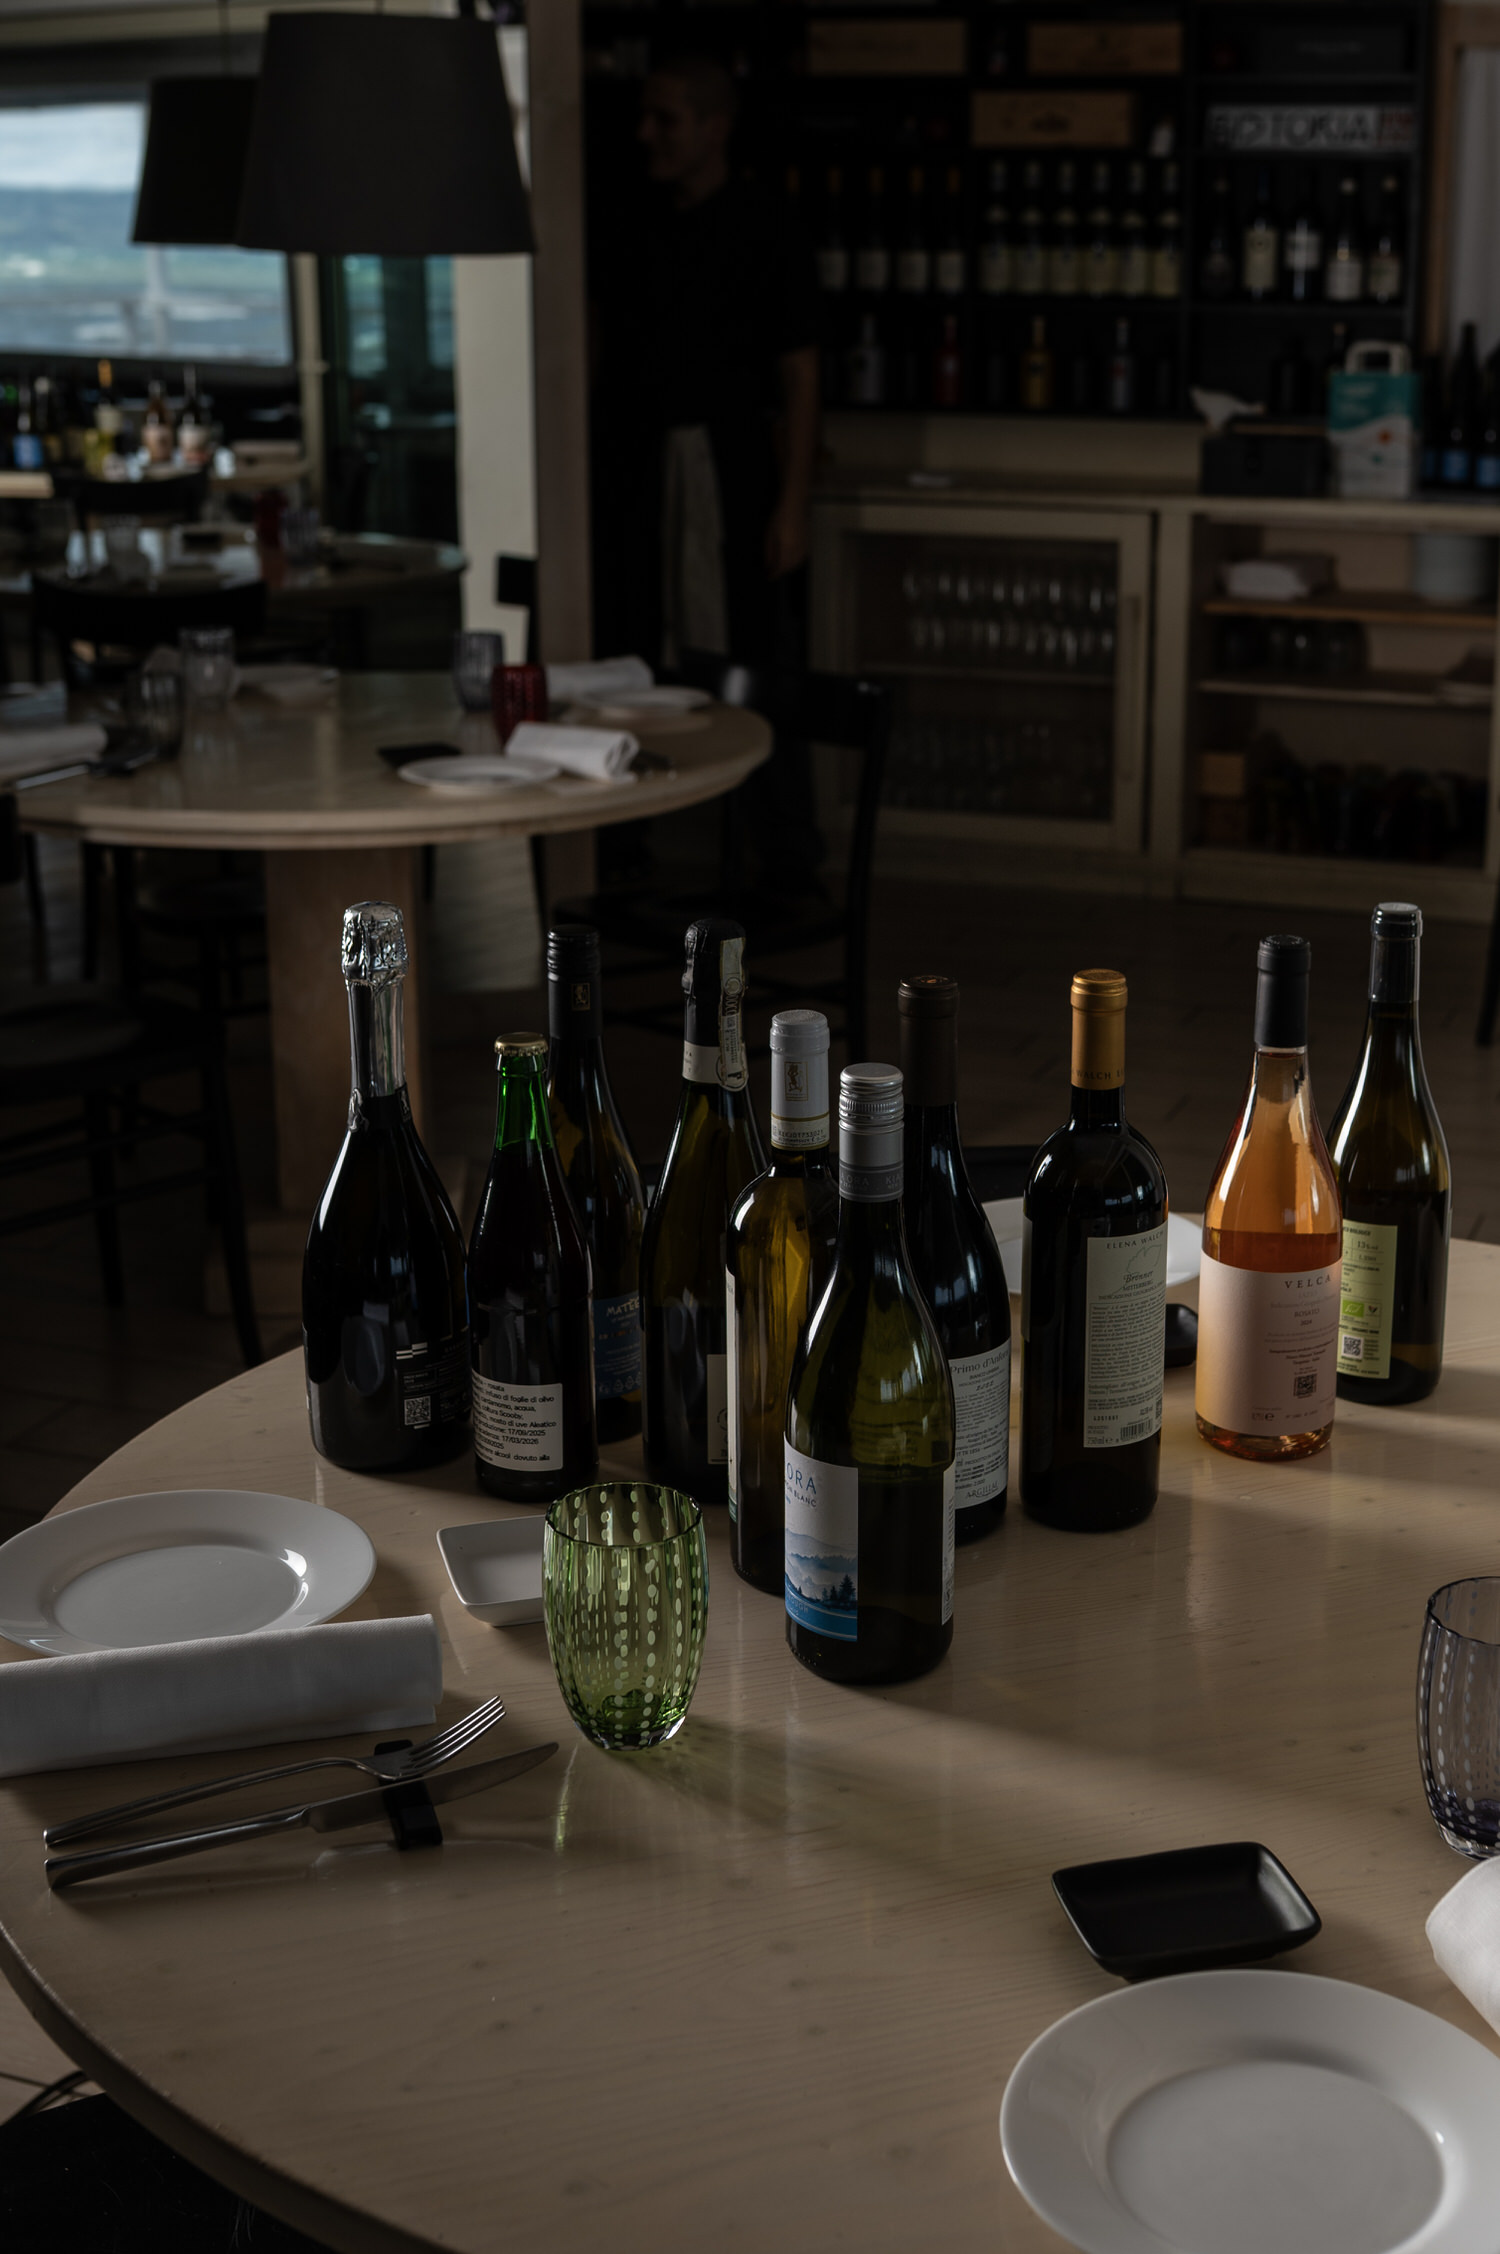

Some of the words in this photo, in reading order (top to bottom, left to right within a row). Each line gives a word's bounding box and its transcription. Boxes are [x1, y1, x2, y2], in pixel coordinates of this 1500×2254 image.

[1107, 1241, 1137, 1249] ELENA
[1141, 1231, 1163, 1244] WALCH
[1285, 1275, 1331, 1289] VELCA
[1295, 1309, 1320, 1319] ROSATO
[510, 1395, 529, 1403] foglie
[538, 1395, 555, 1403] olivo
[787, 1462, 817, 1495] ORA
[794, 1491, 817, 1507] BLANC
